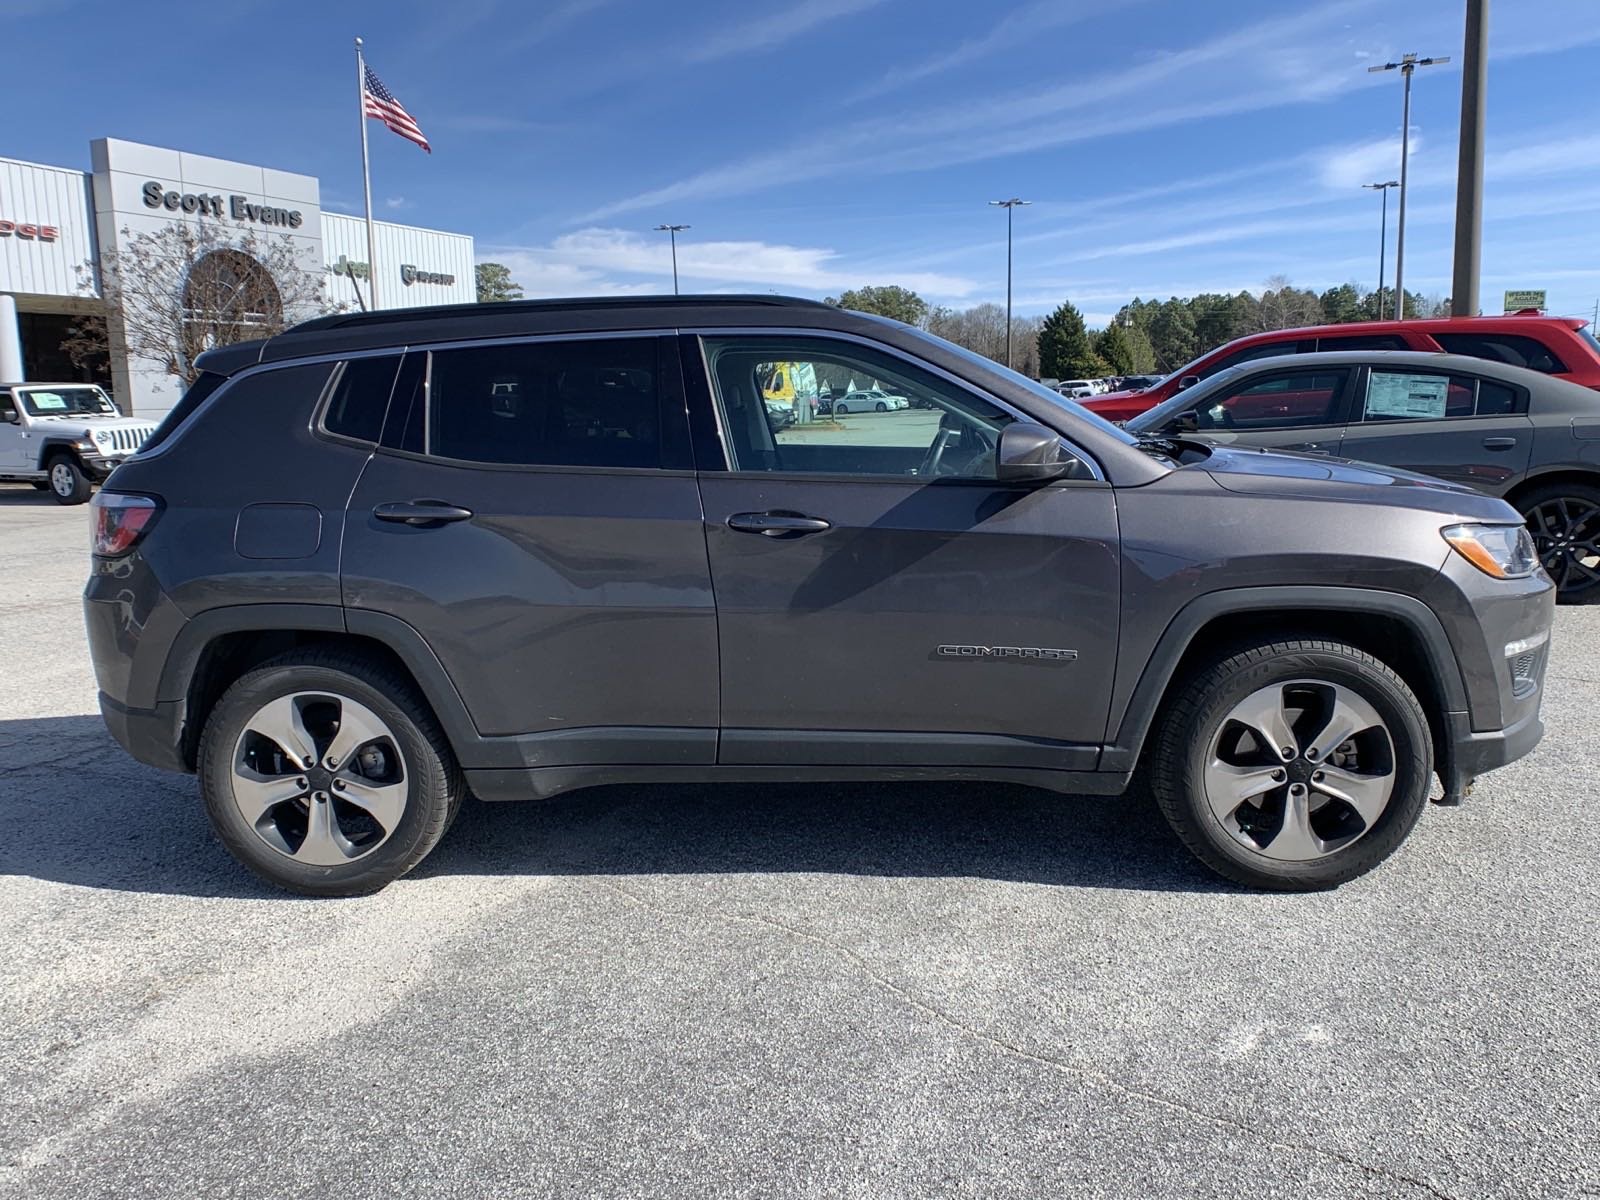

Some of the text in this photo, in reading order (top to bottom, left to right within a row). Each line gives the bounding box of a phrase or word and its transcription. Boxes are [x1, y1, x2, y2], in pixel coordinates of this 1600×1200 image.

[143, 181, 302, 229] Scott Evans
[937, 645, 1078, 660] COMPASS
